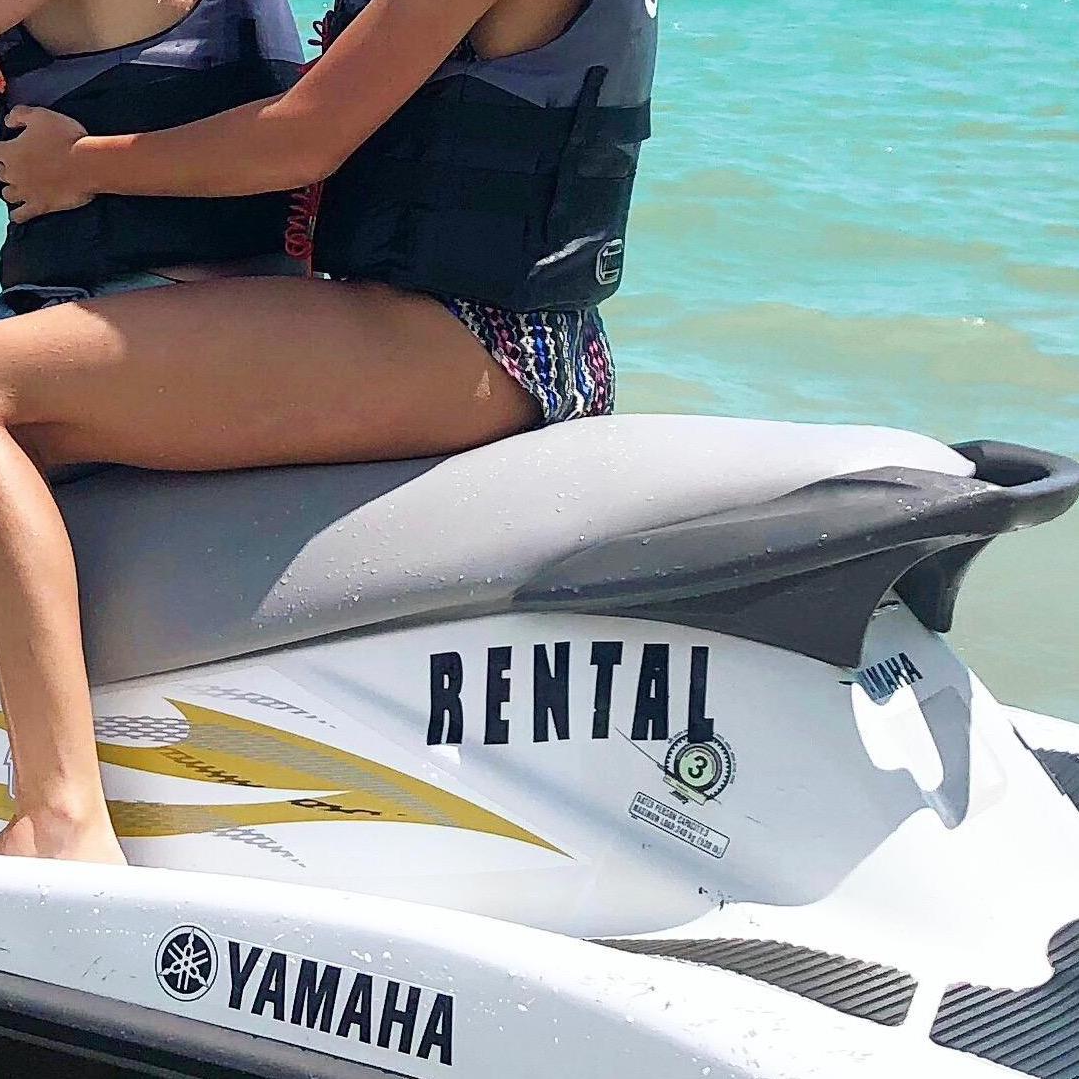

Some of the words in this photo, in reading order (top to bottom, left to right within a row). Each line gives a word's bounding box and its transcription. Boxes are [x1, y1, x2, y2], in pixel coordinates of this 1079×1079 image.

[426, 641, 715, 745] RENTAL
[687, 755, 708, 779] 3
[228, 940, 454, 1066] YAMAHA
